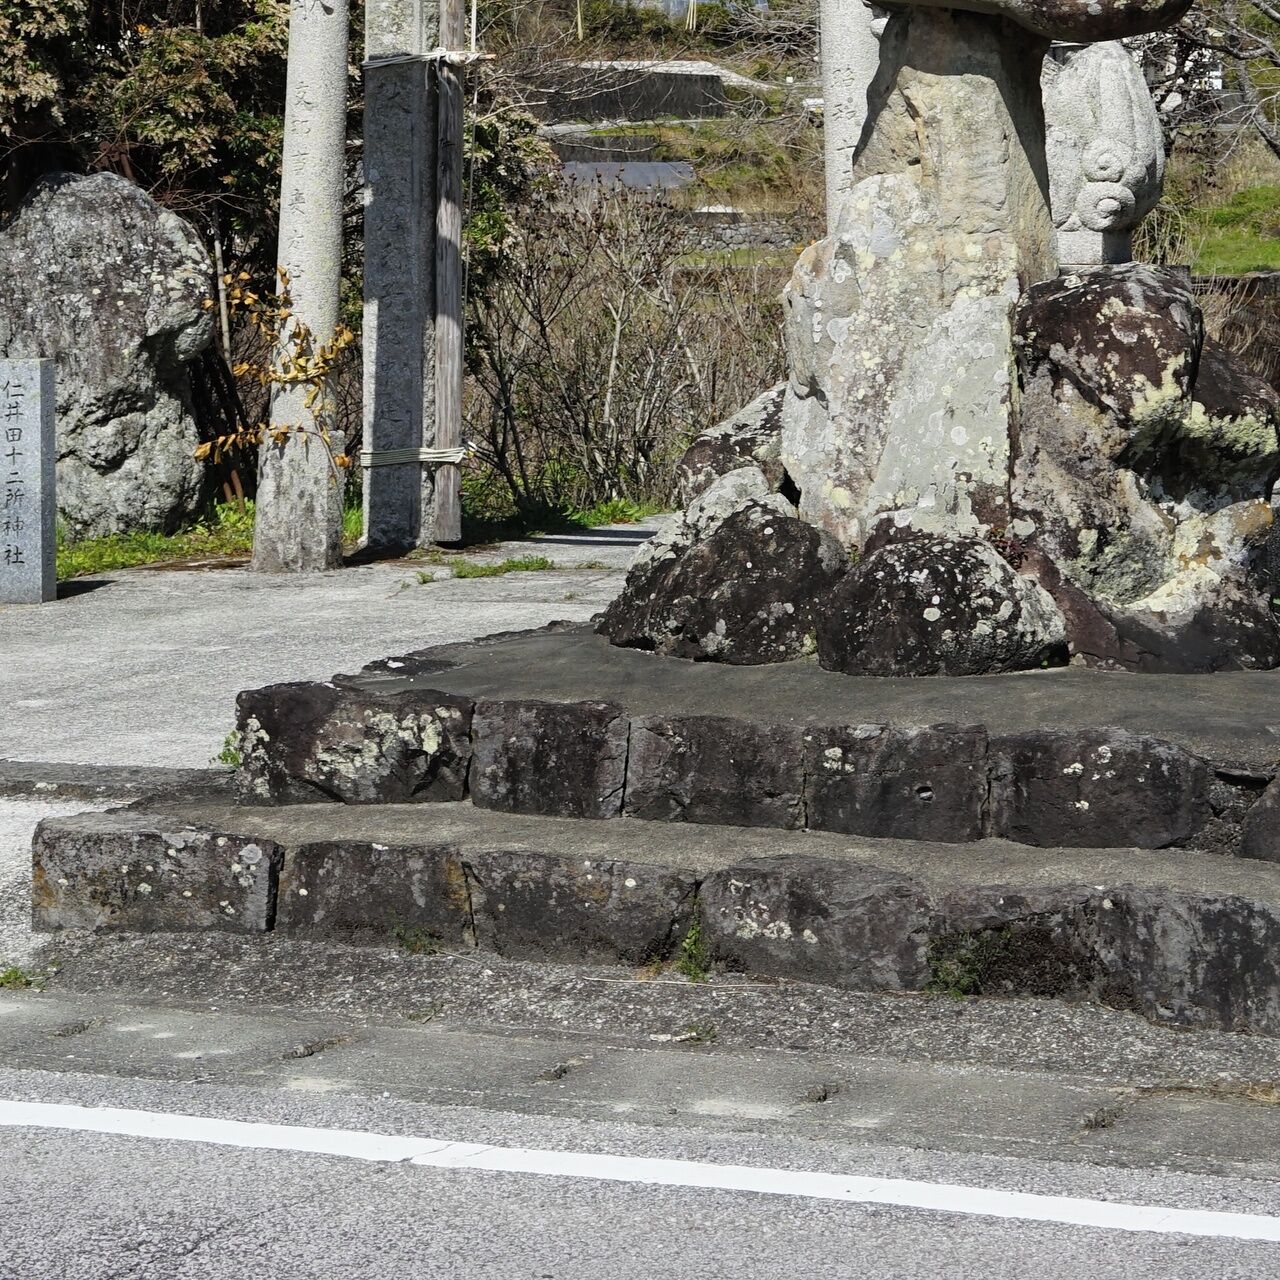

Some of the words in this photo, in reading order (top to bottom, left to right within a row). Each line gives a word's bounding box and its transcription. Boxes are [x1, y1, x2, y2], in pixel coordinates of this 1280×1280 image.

[1, 378, 26, 567] 仁井田十二所神社
